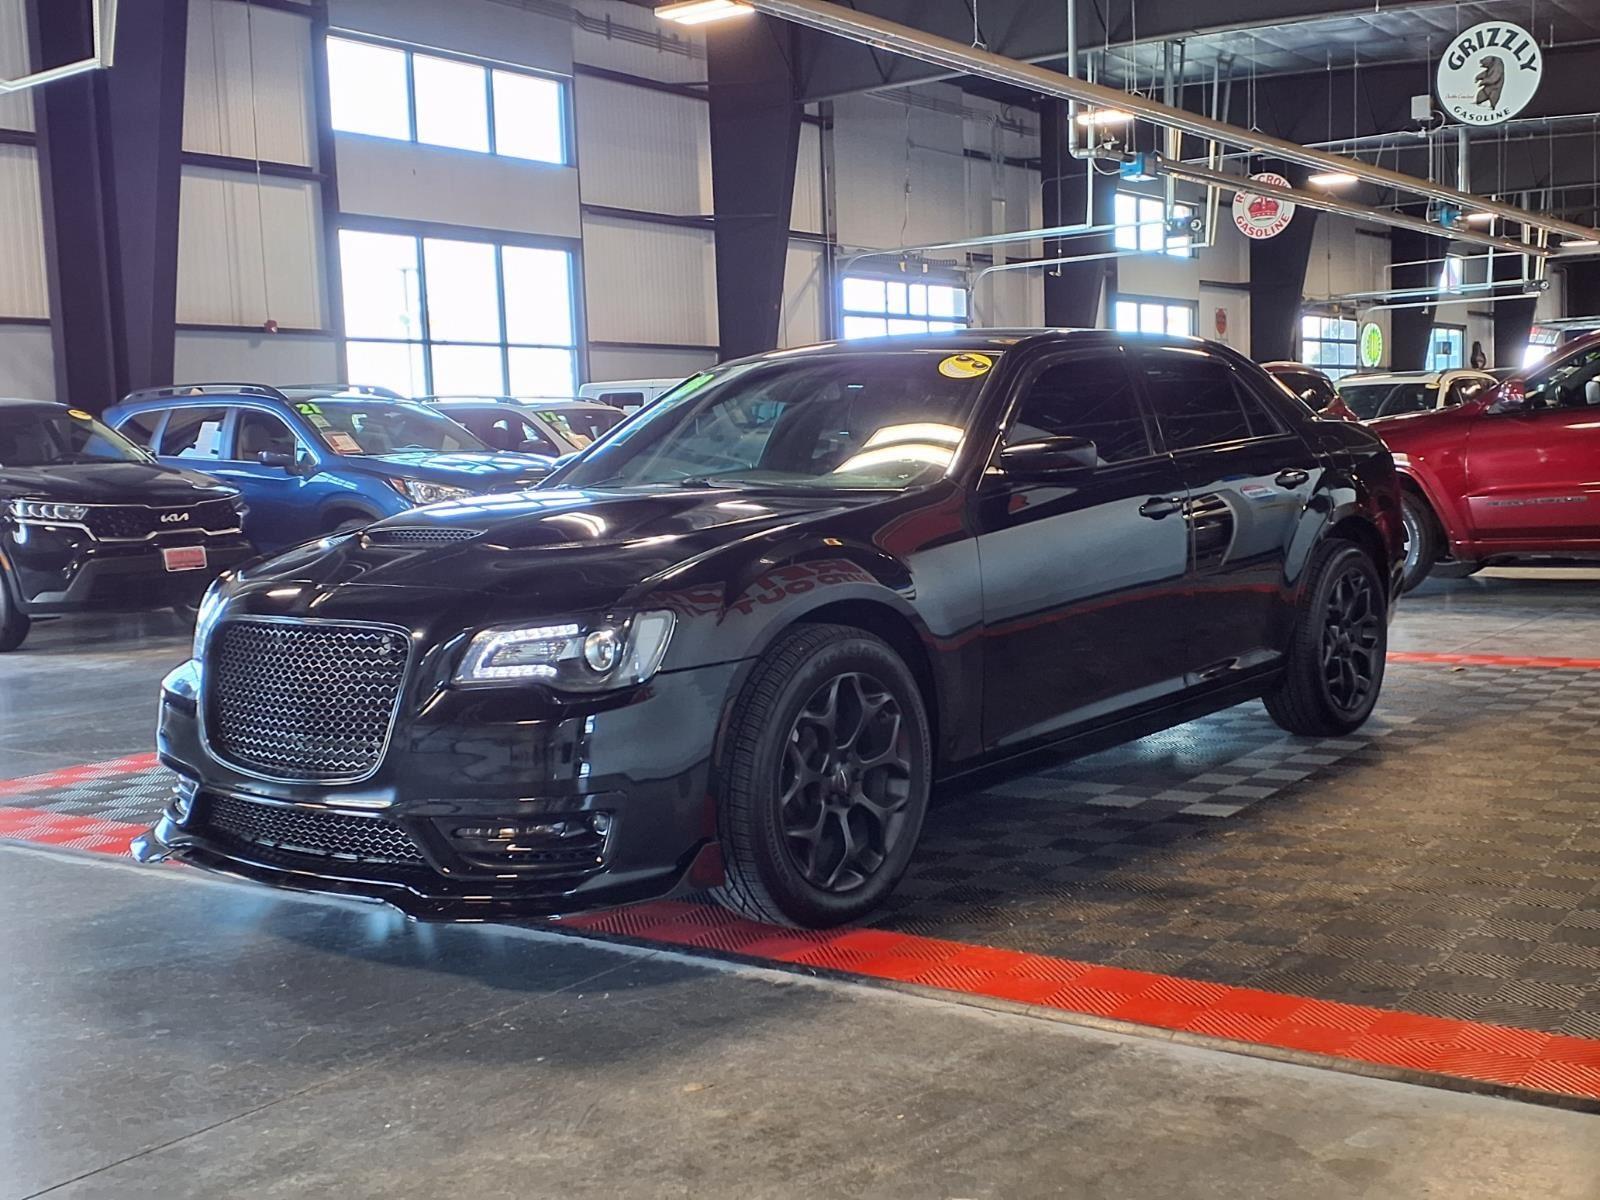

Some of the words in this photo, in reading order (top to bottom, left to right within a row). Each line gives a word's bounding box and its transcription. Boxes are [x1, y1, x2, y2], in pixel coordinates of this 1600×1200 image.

[1448, 27, 1538, 72] GRIZZLY
[1453, 105, 1511, 122] GASOLINE
[1257, 174, 1289, 188] CRO
[1236, 213, 1290, 237] GASOLINE
